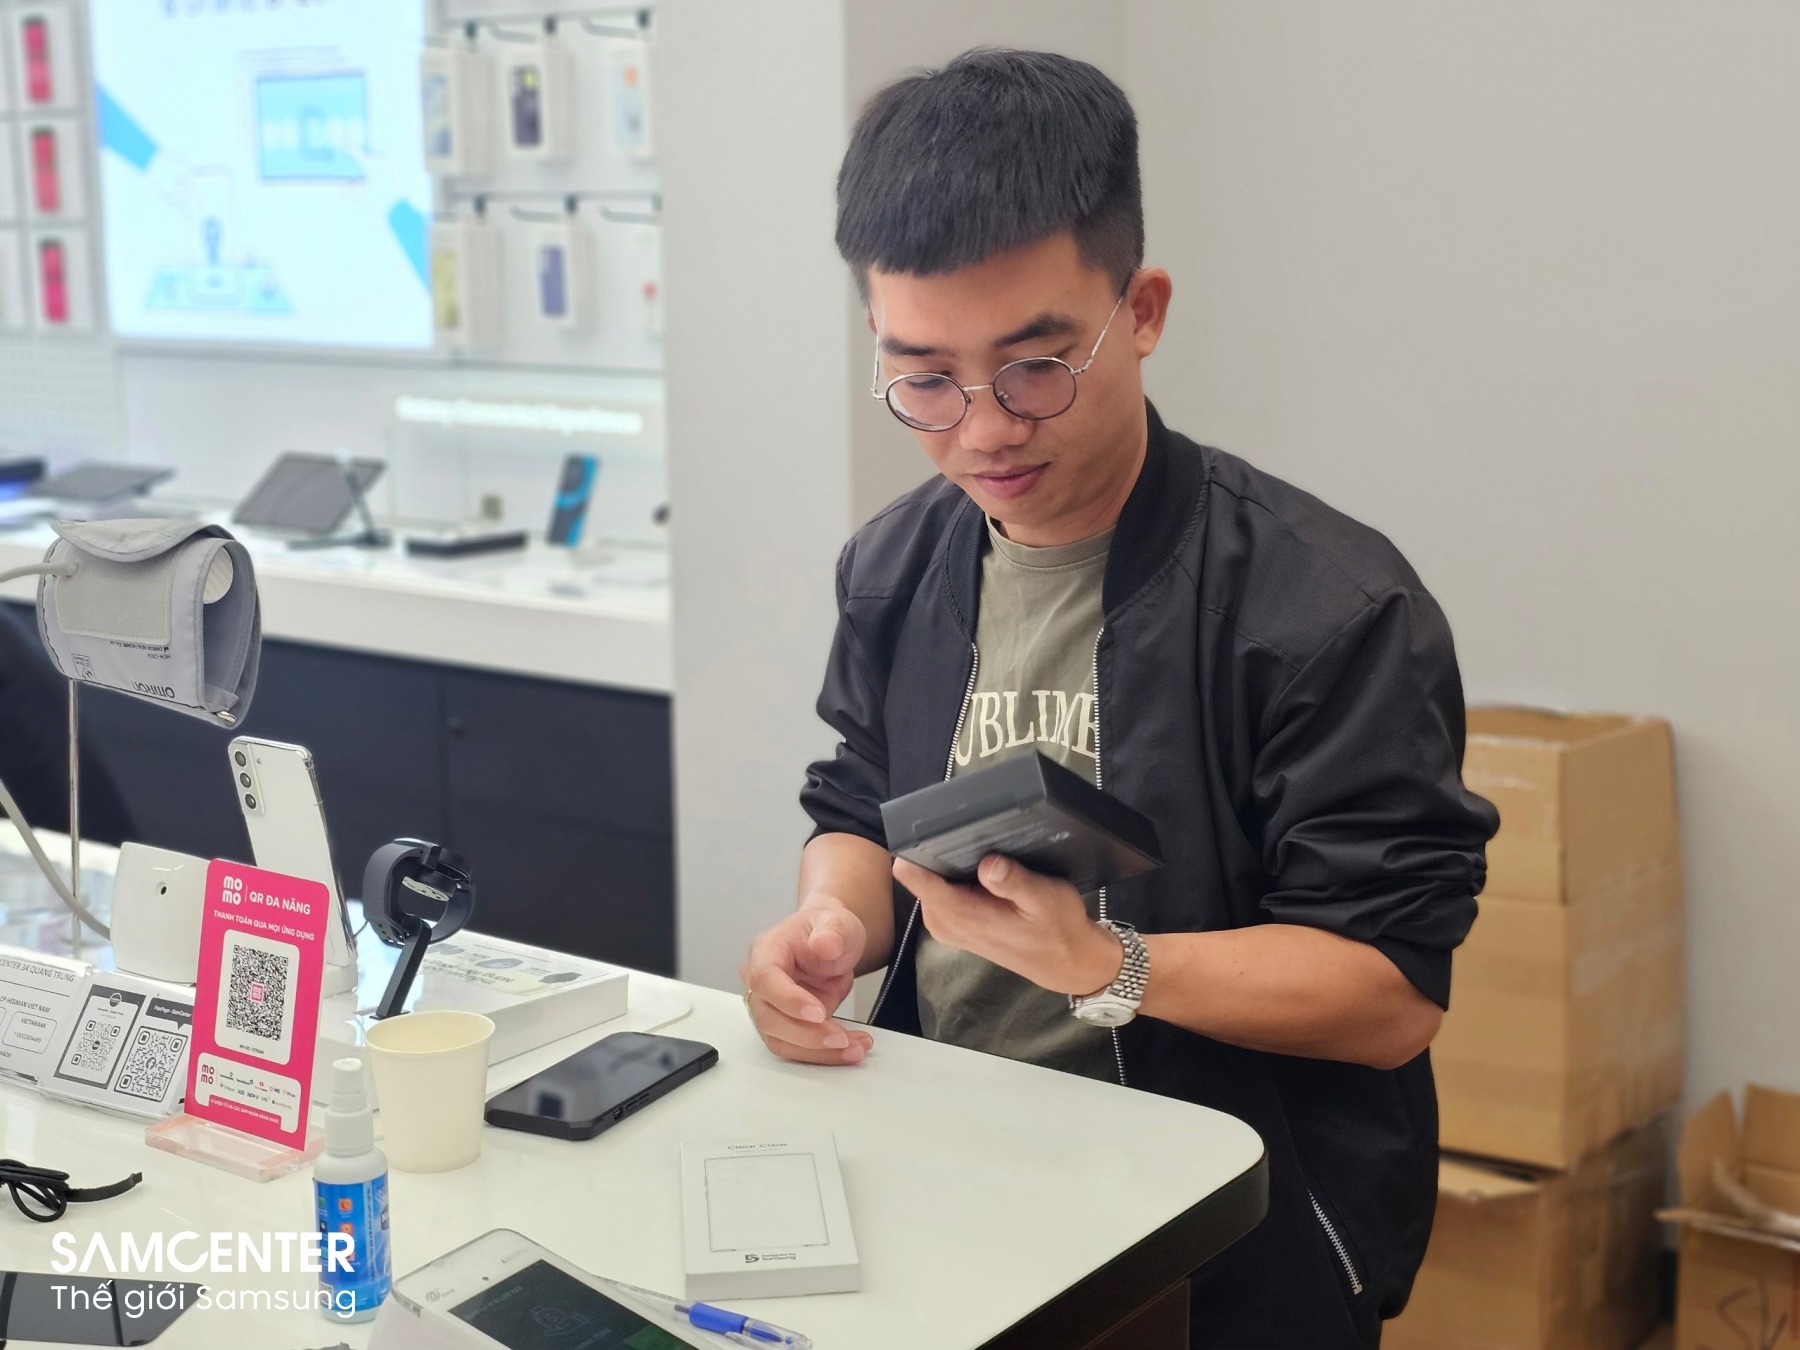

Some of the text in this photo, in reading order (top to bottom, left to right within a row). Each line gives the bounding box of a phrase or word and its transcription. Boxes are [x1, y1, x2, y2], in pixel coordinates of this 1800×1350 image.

[249, 891, 311, 915] QR ĐA NĂNG
[214, 910, 234, 921] THANH
[235, 916, 252, 926] TOÁN
[253, 920, 267, 929] QUA
[268, 923, 281, 934] MỌI
[296, 930, 315, 941] DỤNG
[21, 963, 29, 971] 34
[29, 965, 52, 978] QUANG
[53, 970, 76, 982] TRUNG
